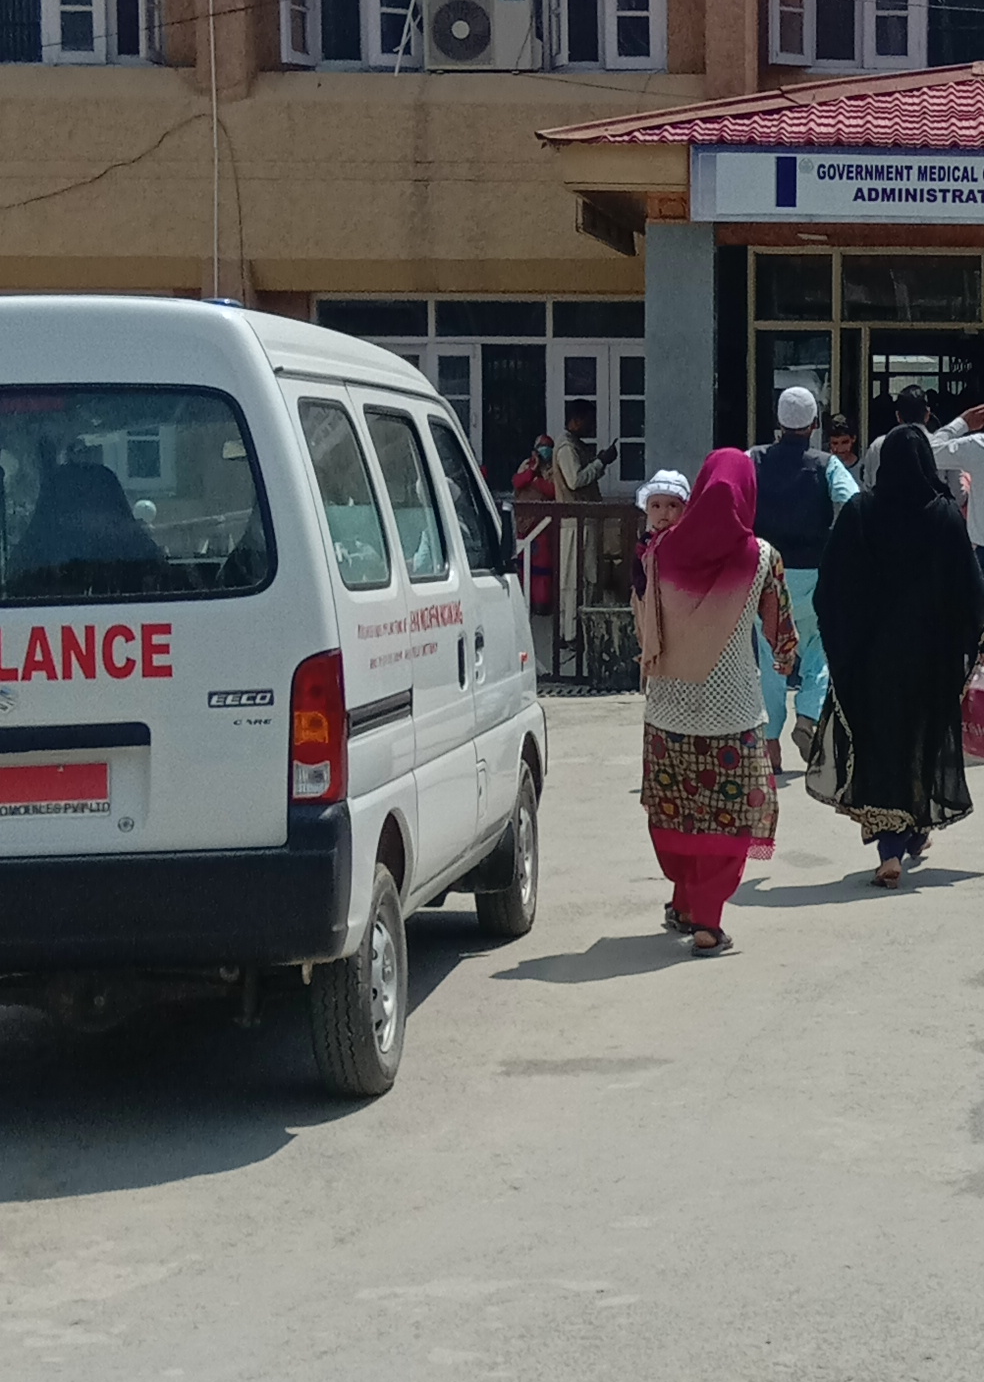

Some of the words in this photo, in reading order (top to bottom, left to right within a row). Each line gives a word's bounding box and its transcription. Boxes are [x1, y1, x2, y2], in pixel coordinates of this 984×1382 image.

[817, 164, 913, 182] GOVERNMENT
[917, 166, 978, 182] MEDICAL
[210, 693, 271, 706] EECO
